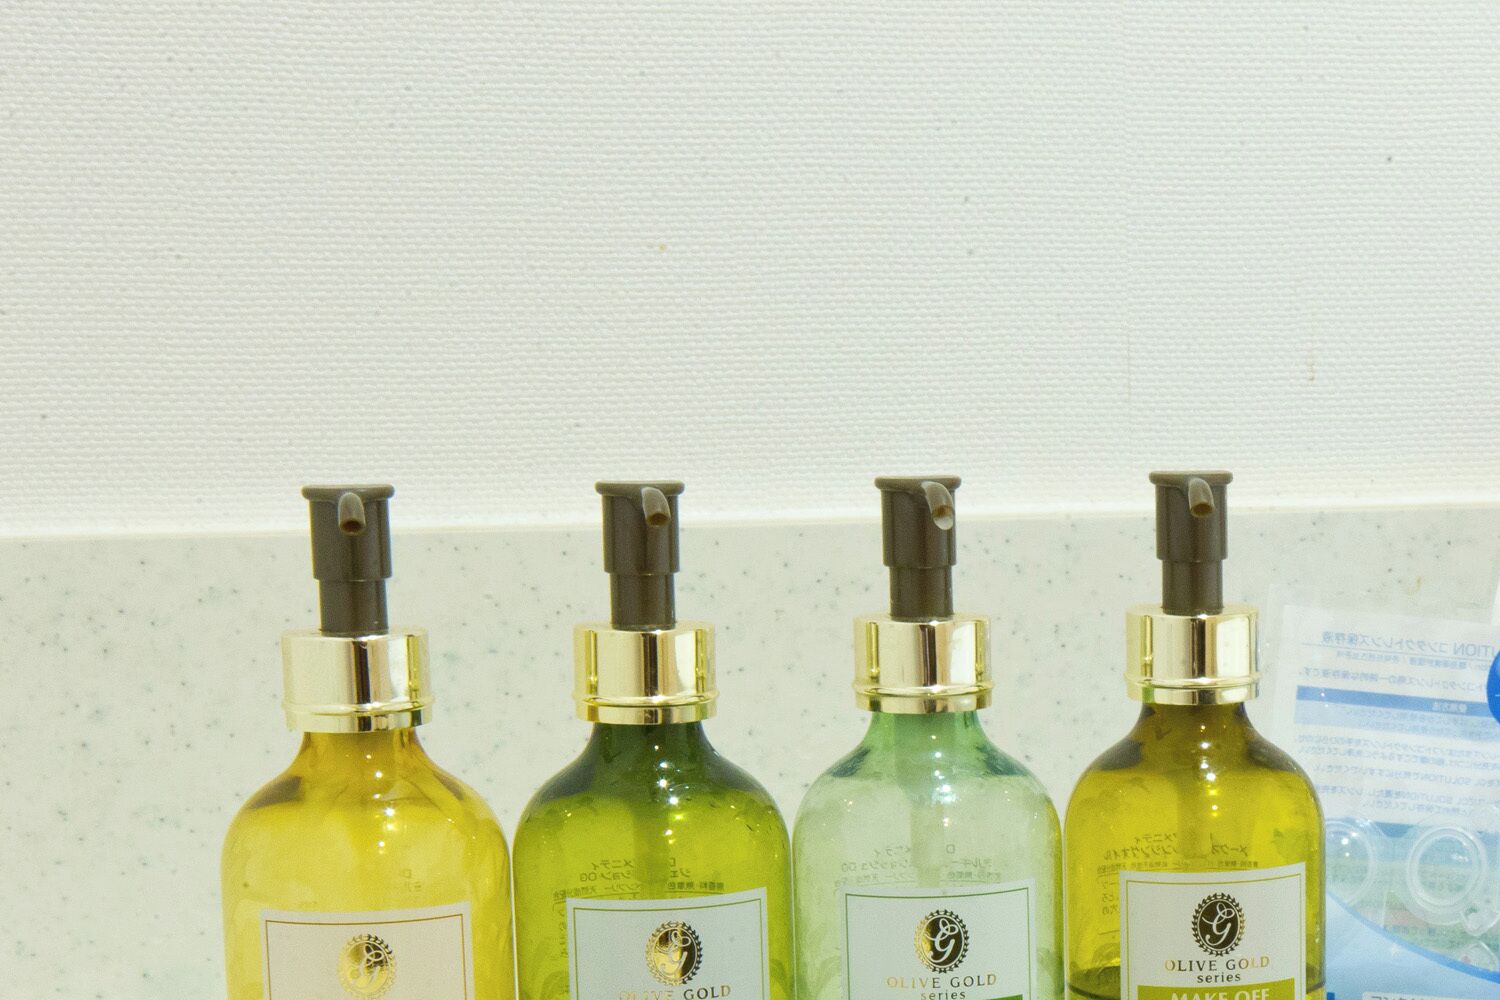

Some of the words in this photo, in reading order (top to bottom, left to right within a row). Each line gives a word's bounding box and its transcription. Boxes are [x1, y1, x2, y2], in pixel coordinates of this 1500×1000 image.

[1164, 959, 1218, 973] OLIVE
[1225, 956, 1271, 971] GOLD
[886, 976, 941, 989] OLIVE
[950, 973, 998, 988] GOLD
[1197, 972, 1241, 985] series
[683, 985, 732, 1000] GOLD
[920, 990, 967, 1000] series
